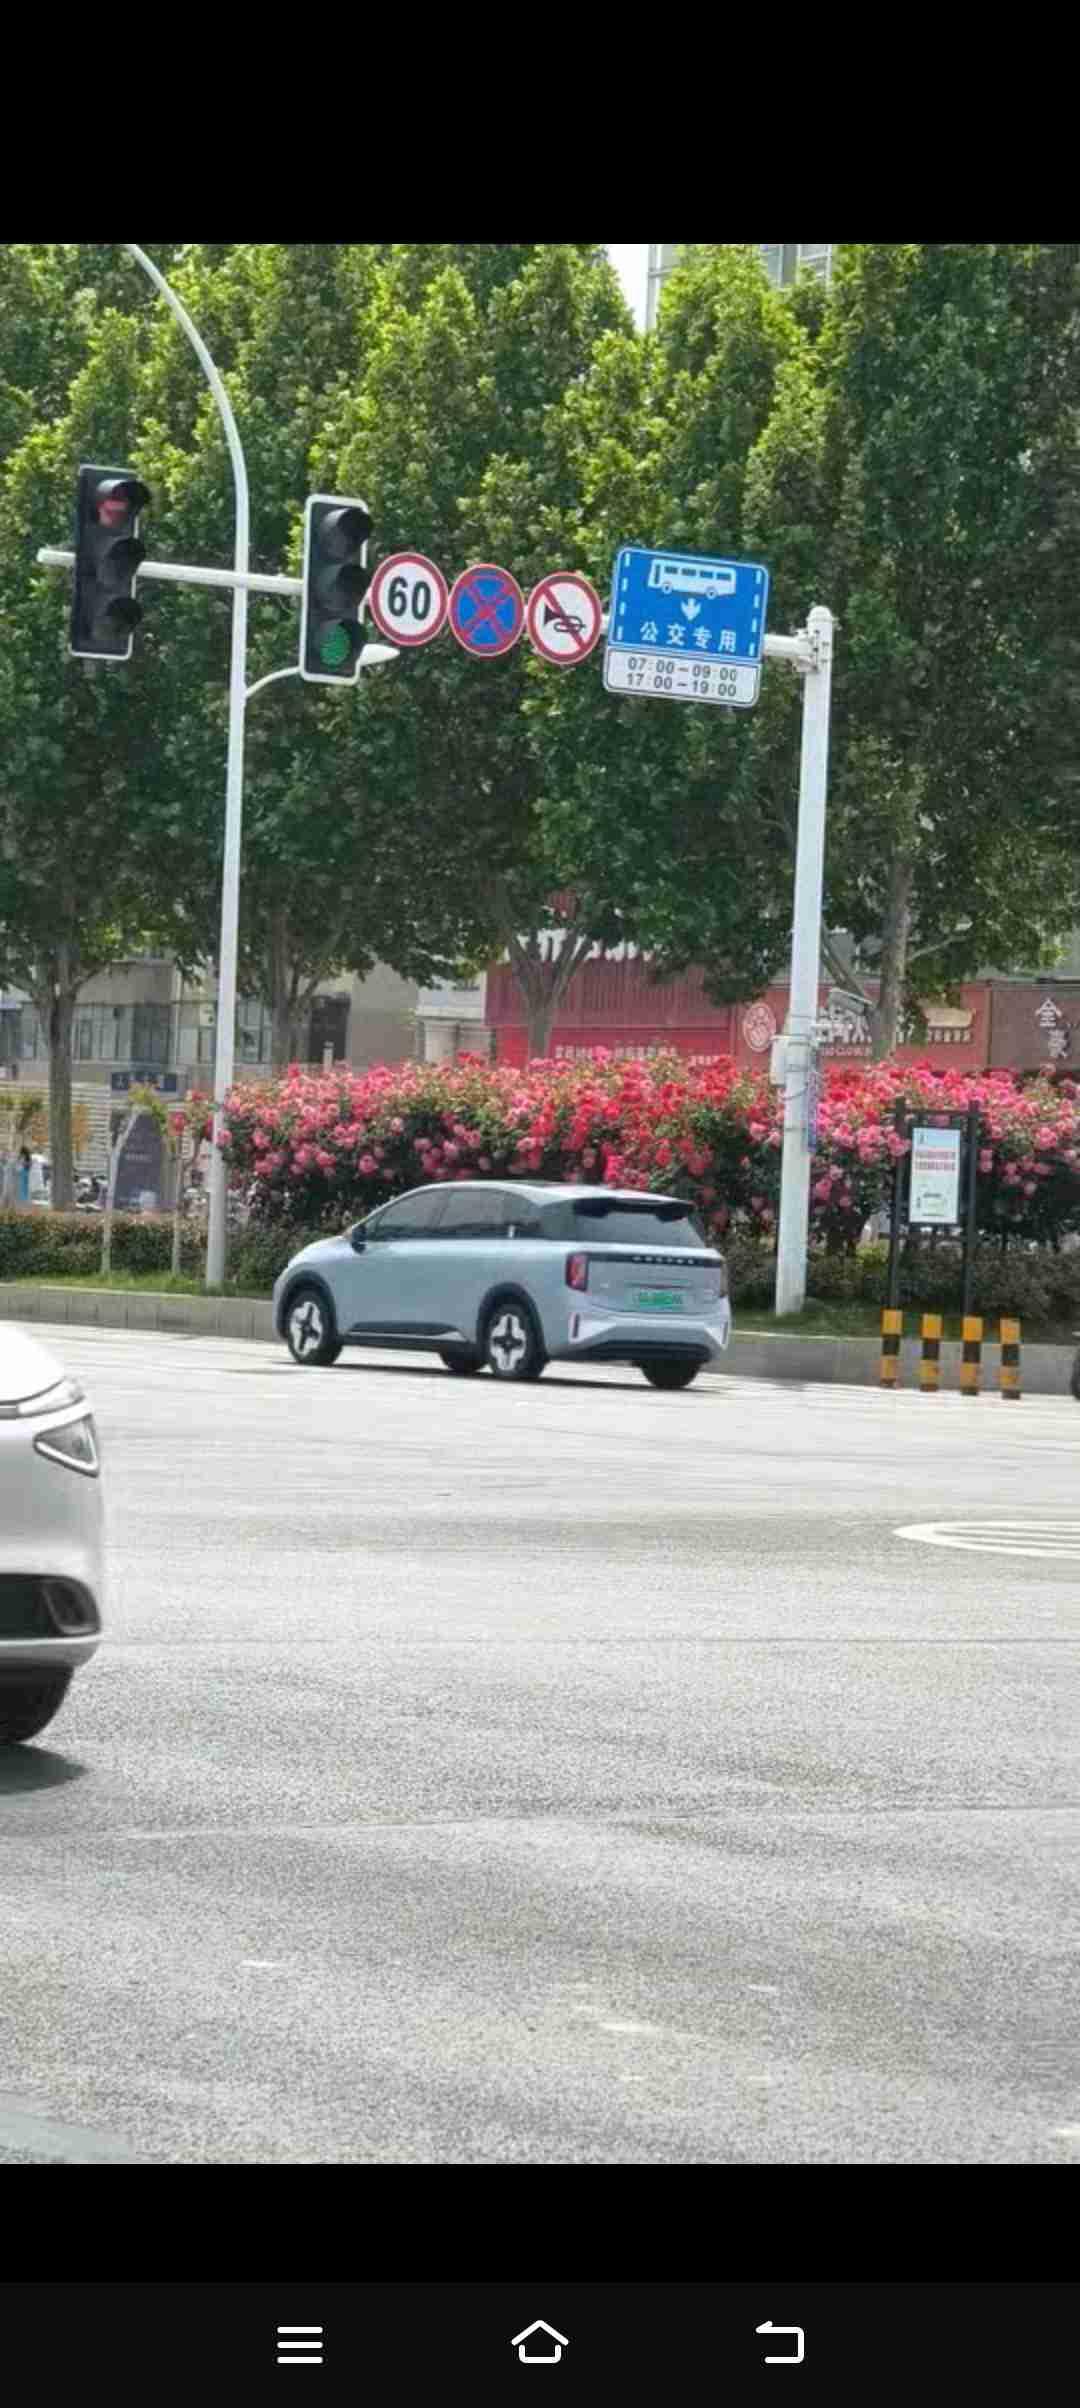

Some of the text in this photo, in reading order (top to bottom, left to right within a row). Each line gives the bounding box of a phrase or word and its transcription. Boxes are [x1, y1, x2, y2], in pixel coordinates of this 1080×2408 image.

[388, 576, 431, 620] 60
[640, 621, 737, 653] 公交专用
